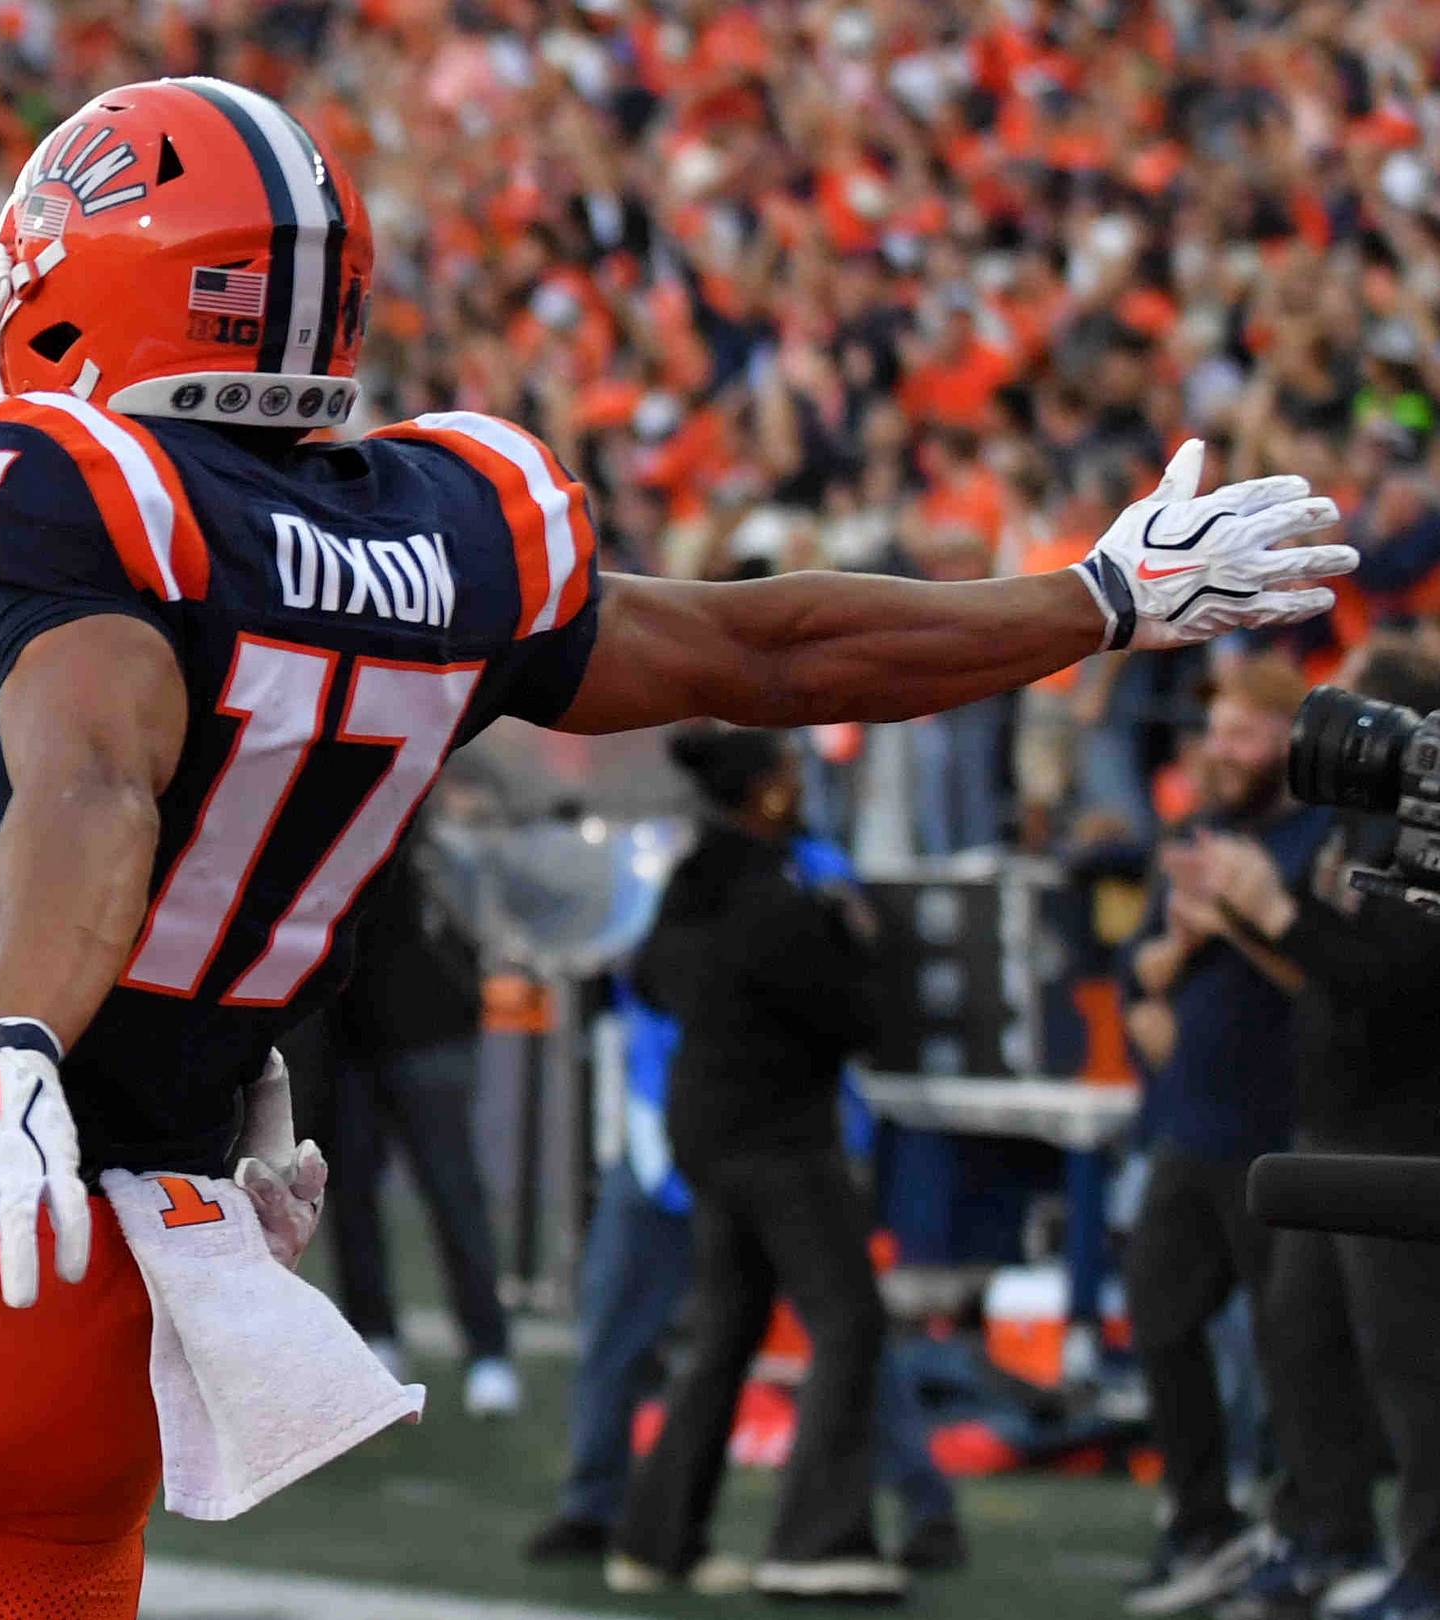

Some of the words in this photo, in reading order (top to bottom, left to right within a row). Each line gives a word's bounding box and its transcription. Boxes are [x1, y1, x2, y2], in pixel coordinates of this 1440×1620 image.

[297, 328, 312, 344] 17
[270, 512, 457, 629] DIXON
[116, 631, 489, 1008] 17
